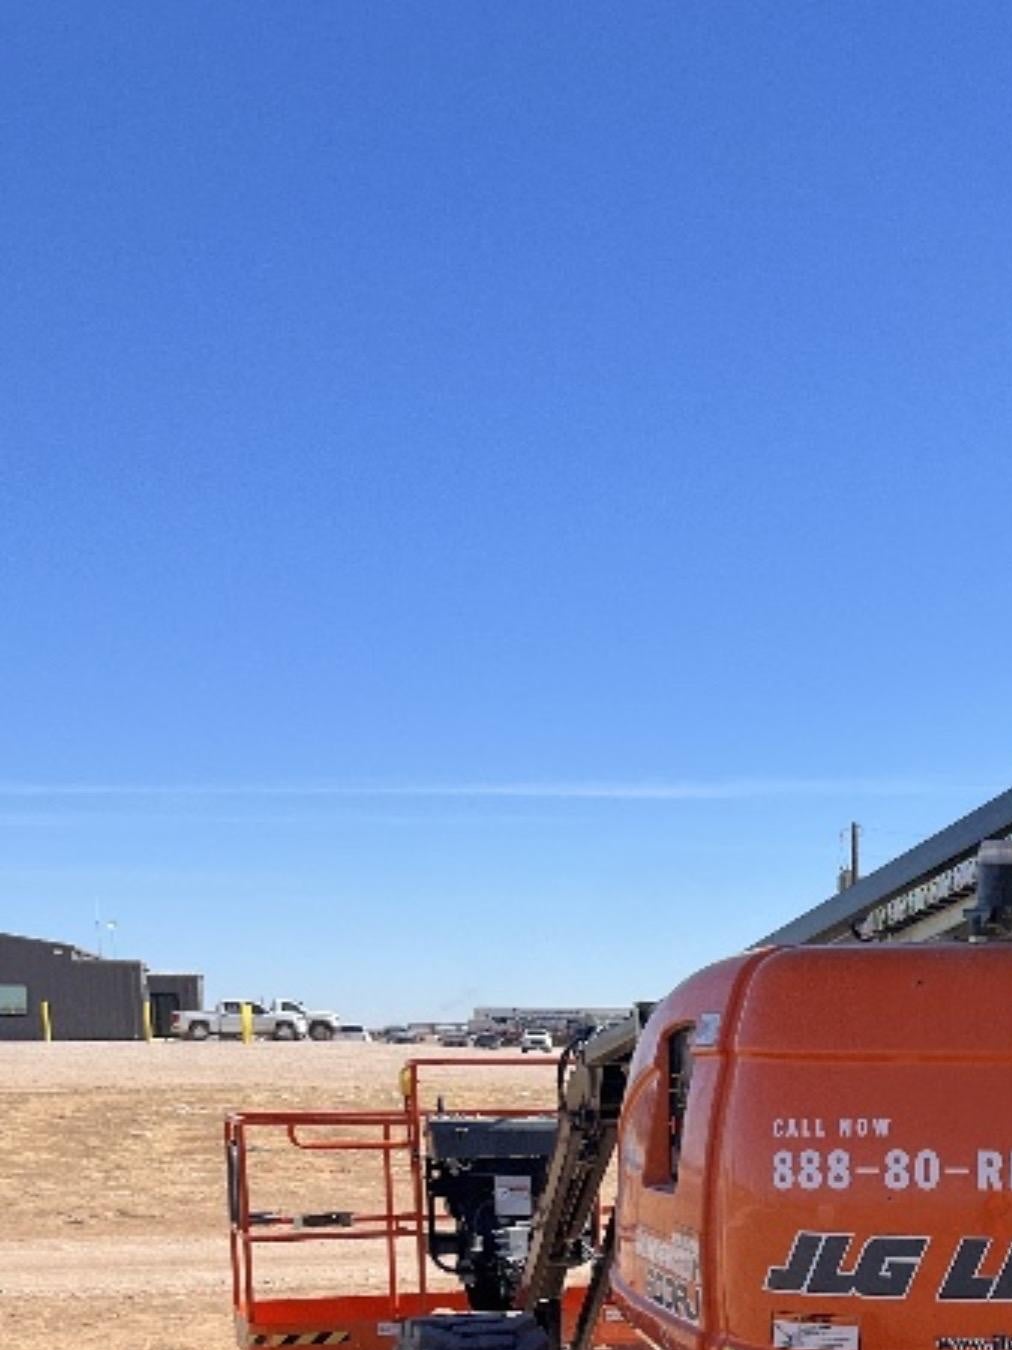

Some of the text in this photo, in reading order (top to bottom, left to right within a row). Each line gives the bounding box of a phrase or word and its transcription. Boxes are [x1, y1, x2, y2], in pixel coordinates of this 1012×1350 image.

[772, 1118, 892, 1138] CALL NOW
[761, 1230, 932, 1300] JLG
